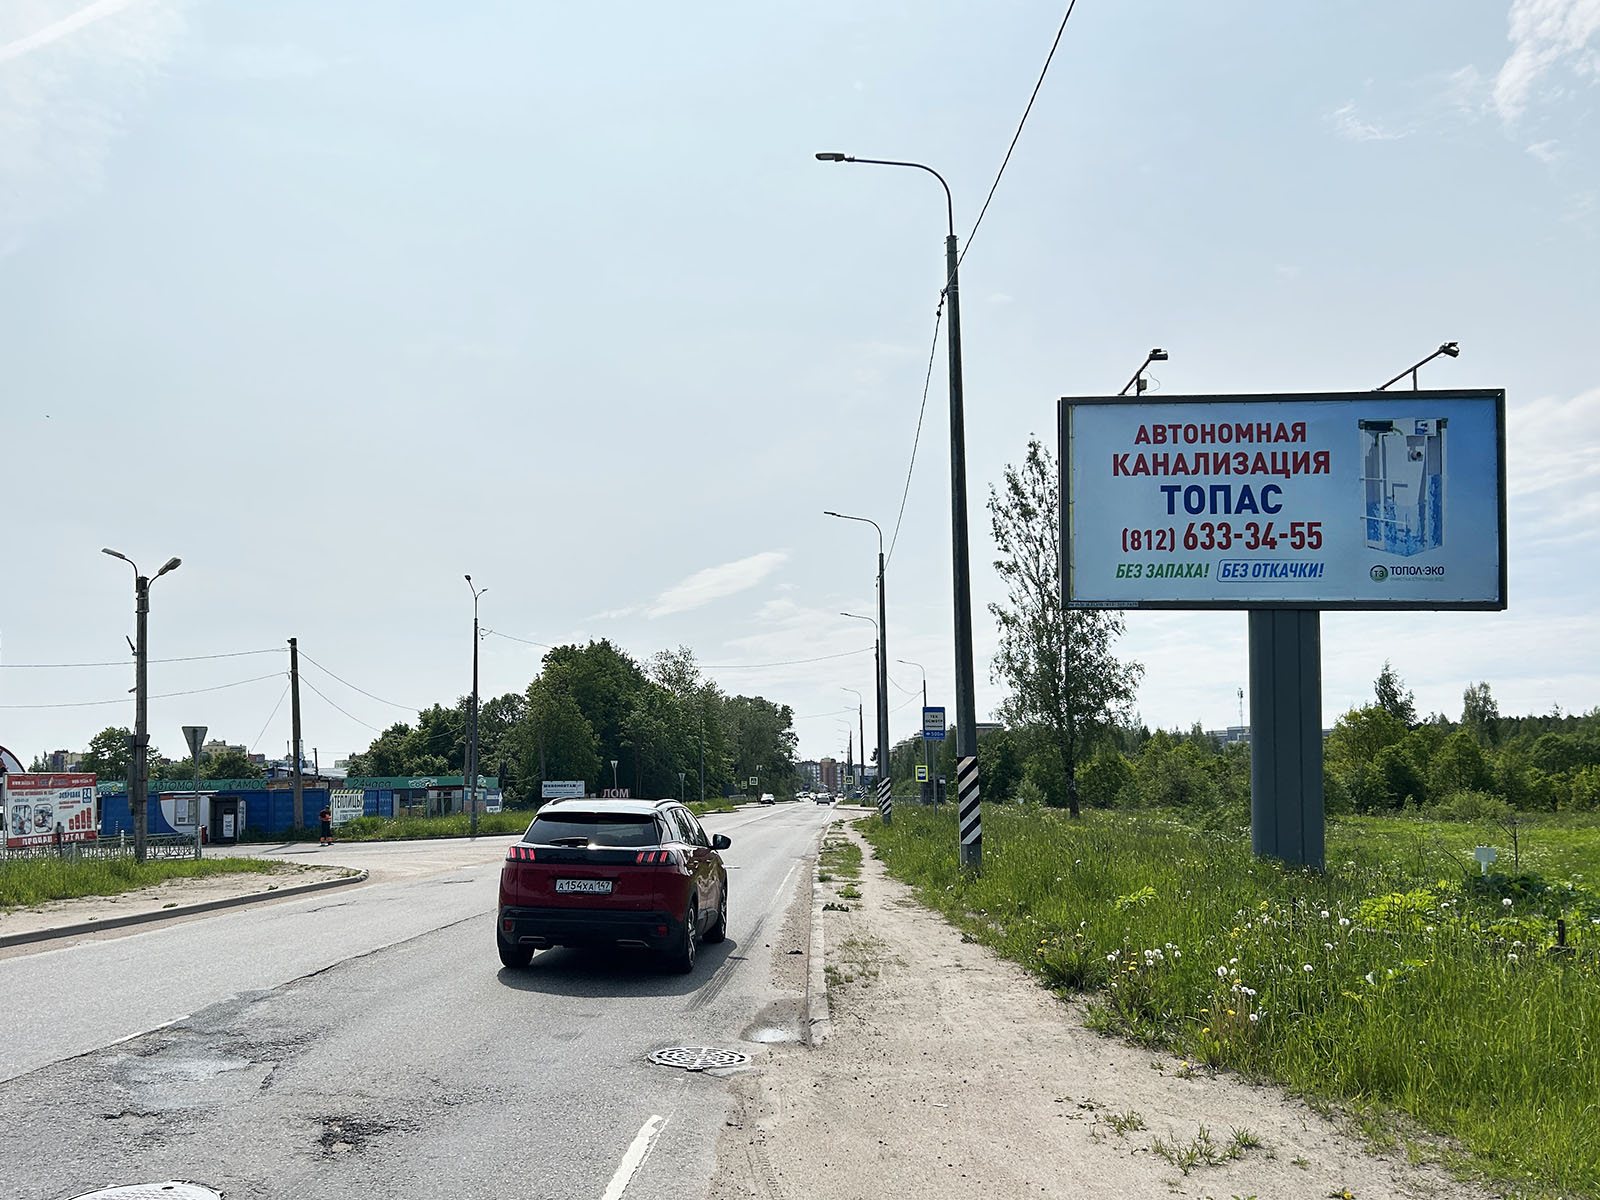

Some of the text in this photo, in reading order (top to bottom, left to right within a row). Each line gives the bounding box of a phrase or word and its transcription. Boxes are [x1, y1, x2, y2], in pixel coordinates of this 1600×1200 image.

[1135, 422, 1306, 444] АВТОНОМНАЯ
[1113, 451, 1330, 479] КАНАЛИЗАЦИЯ
[1161, 484, 1283, 514] ТОПАС
[1122, 522, 1322, 552] (812) 633-34-55
[1116, 563, 1210, 578] БЕЗ ЗАПАХА!
[1222, 563, 1324, 578] БЕЗ ОТКАЧКИ!
[84, 789, 91, 798] 24
[603, 788, 629, 798] ЛОМ
[334, 795, 363, 808] ТЕПЛИЦЫ
[22, 836, 53, 845] ПРОПАН
